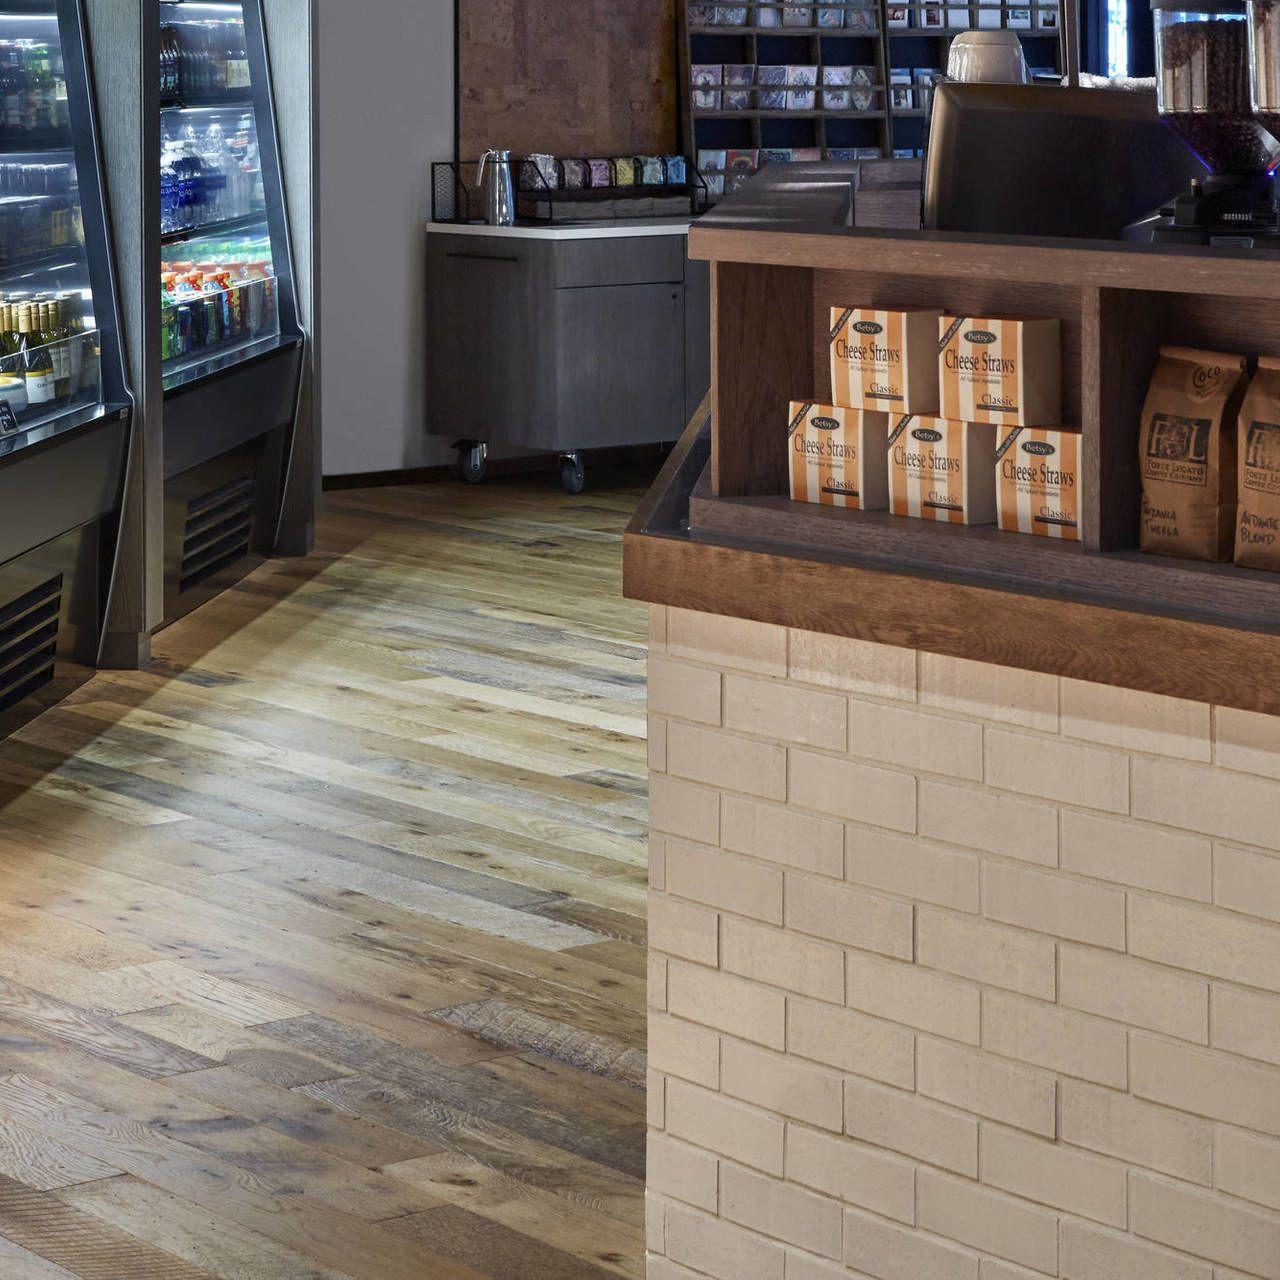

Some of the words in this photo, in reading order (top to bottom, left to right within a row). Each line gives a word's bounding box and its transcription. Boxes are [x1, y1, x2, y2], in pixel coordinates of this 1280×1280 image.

[836, 339, 868, 359] Cheese
[870, 342, 900, 363] Straws
[945, 349, 980, 370] Cheese
[981, 352, 1015, 373] Straws
[794, 434, 825, 454] Cheese
[826, 438, 856, 459] Straws
[894, 446, 926, 467] Cheese
[928, 450, 960, 472] Straws
[1002, 459, 1038, 481] Cheese
[1040, 464, 1074, 486] Straws
